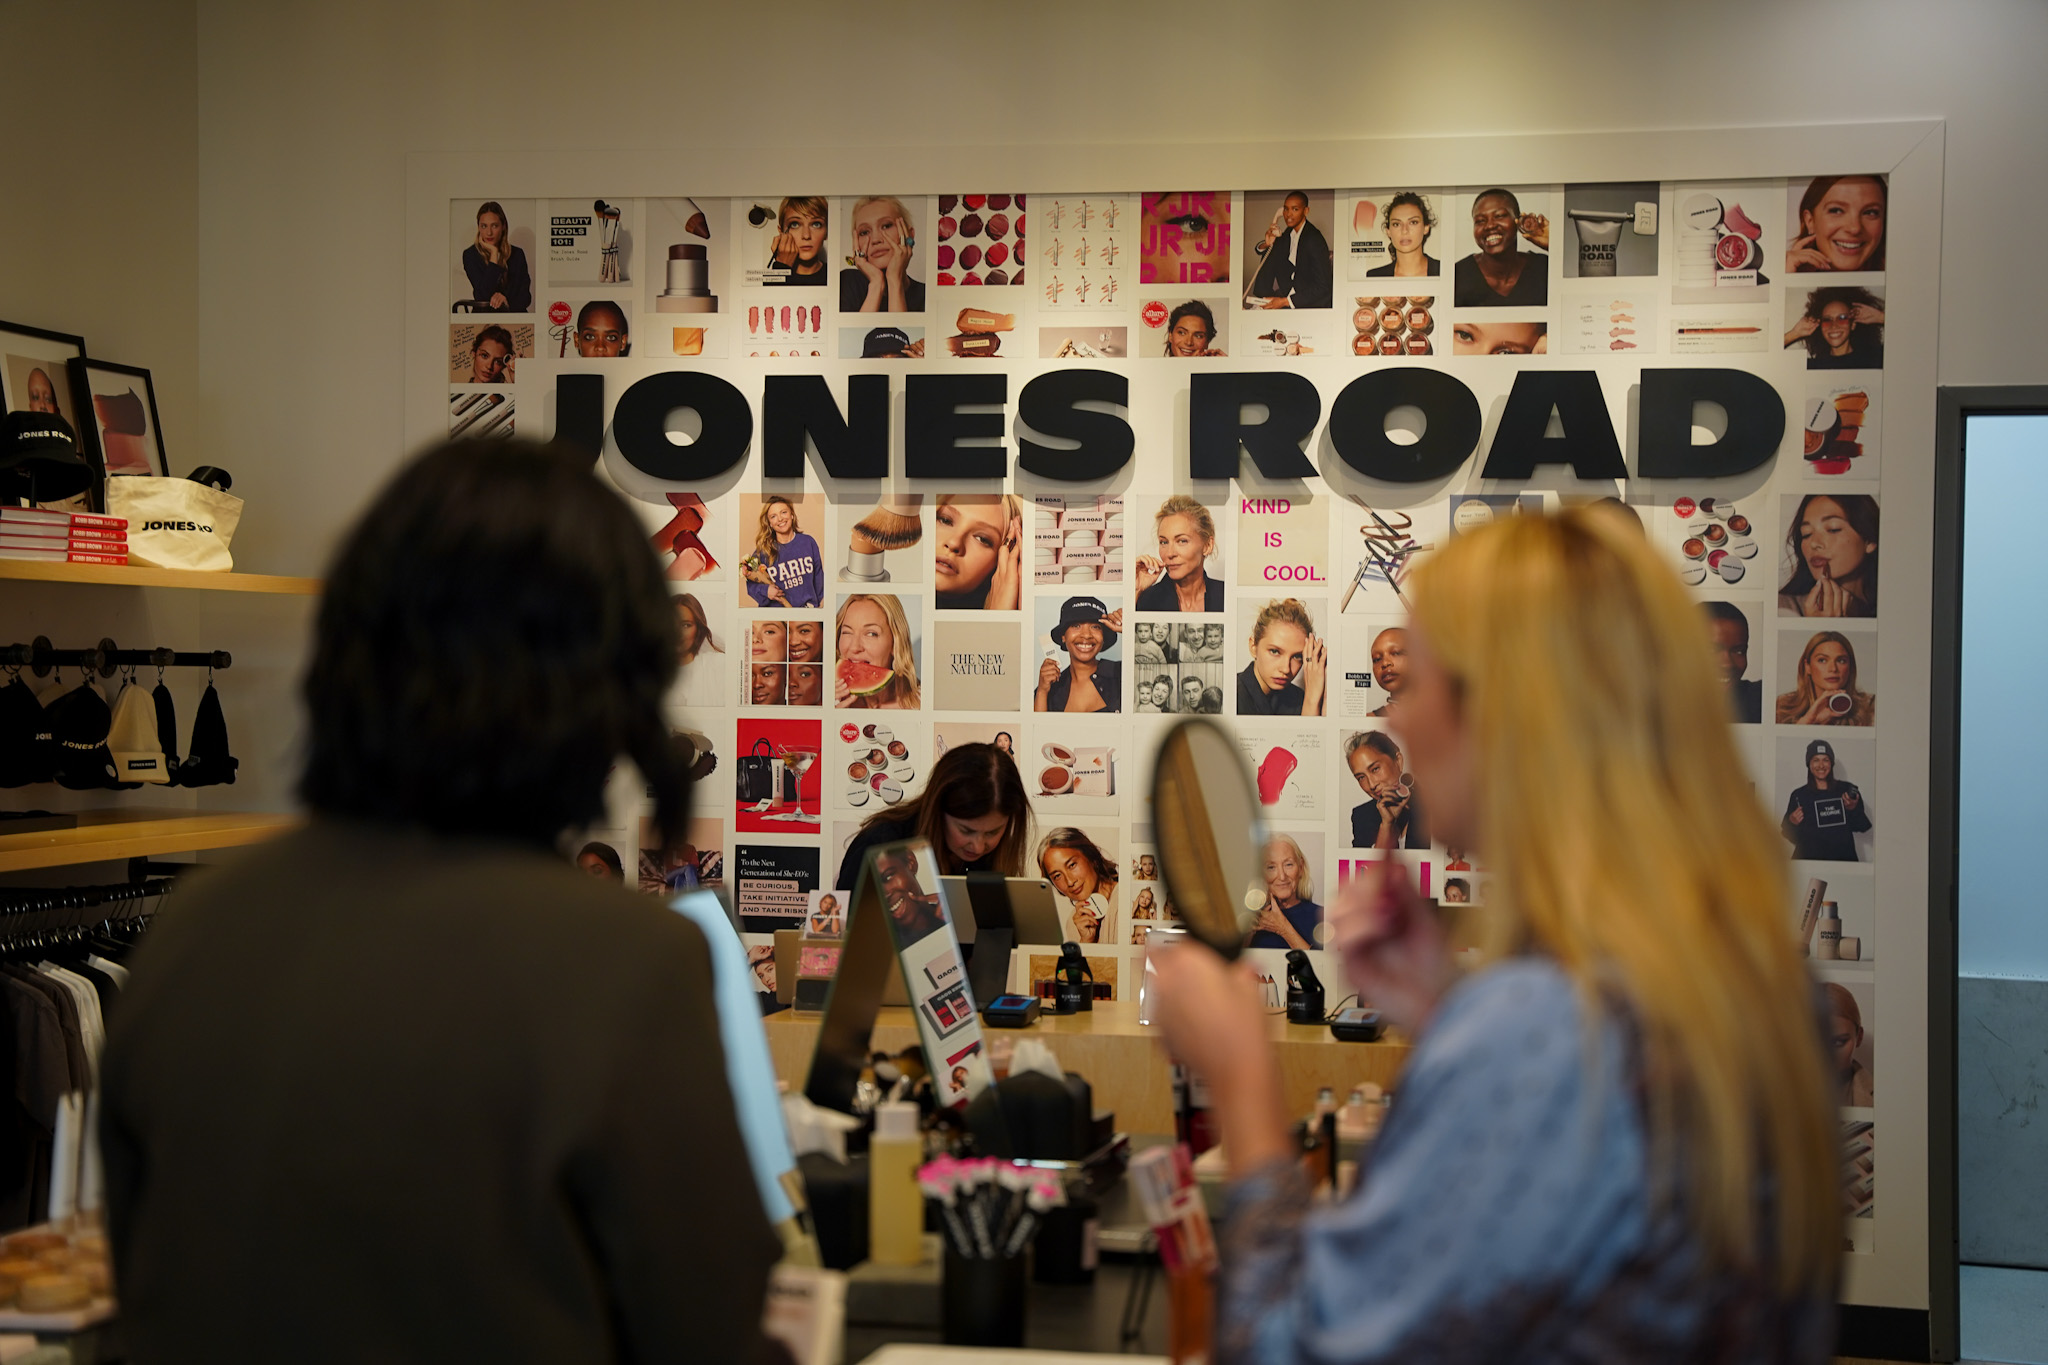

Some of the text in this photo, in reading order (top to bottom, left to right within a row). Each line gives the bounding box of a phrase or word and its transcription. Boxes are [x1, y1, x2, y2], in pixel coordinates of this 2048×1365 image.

[552, 367, 1786, 483] JONES ROAD
[18, 430, 50, 440] JONES
[1242, 499, 1291, 514] KIND
[142, 521, 197, 531] JONES
[1264, 532, 1282, 547] IS
[767, 556, 813, 583] PARIS
[1264, 565, 1326, 581] COOL.
[783, 576, 804, 590] 1999
[951, 654, 1005, 665] THE NEW
[951, 664, 1006, 676] NATURAL
[62, 740, 94, 750] JONES
[741, 858, 750, 866] To
[761, 859, 775, 867] Next
[740, 869, 775, 877] Generation
[765, 895, 808, 903] INITIATIVE,
